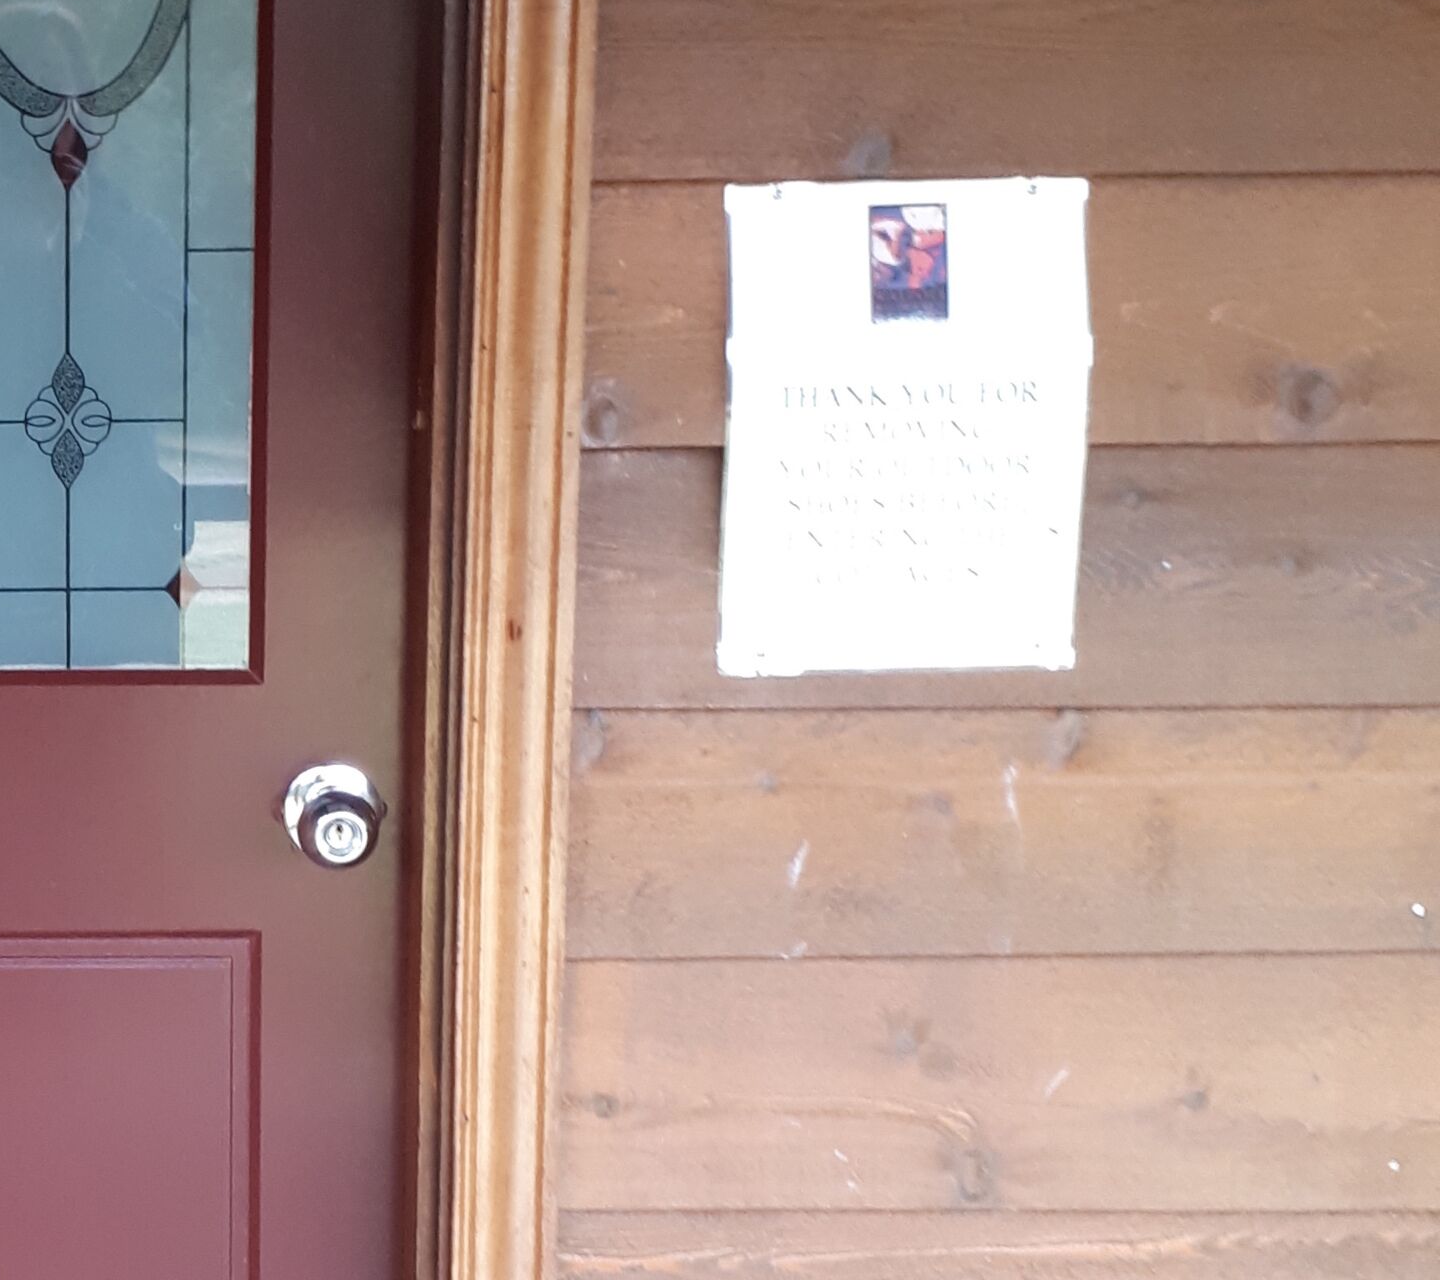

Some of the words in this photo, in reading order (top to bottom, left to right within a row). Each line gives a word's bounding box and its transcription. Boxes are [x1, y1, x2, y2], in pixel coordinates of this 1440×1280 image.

[782, 384, 888, 409] THANK
[901, 383, 958, 407] YOU
[978, 380, 1040, 404] FOR
